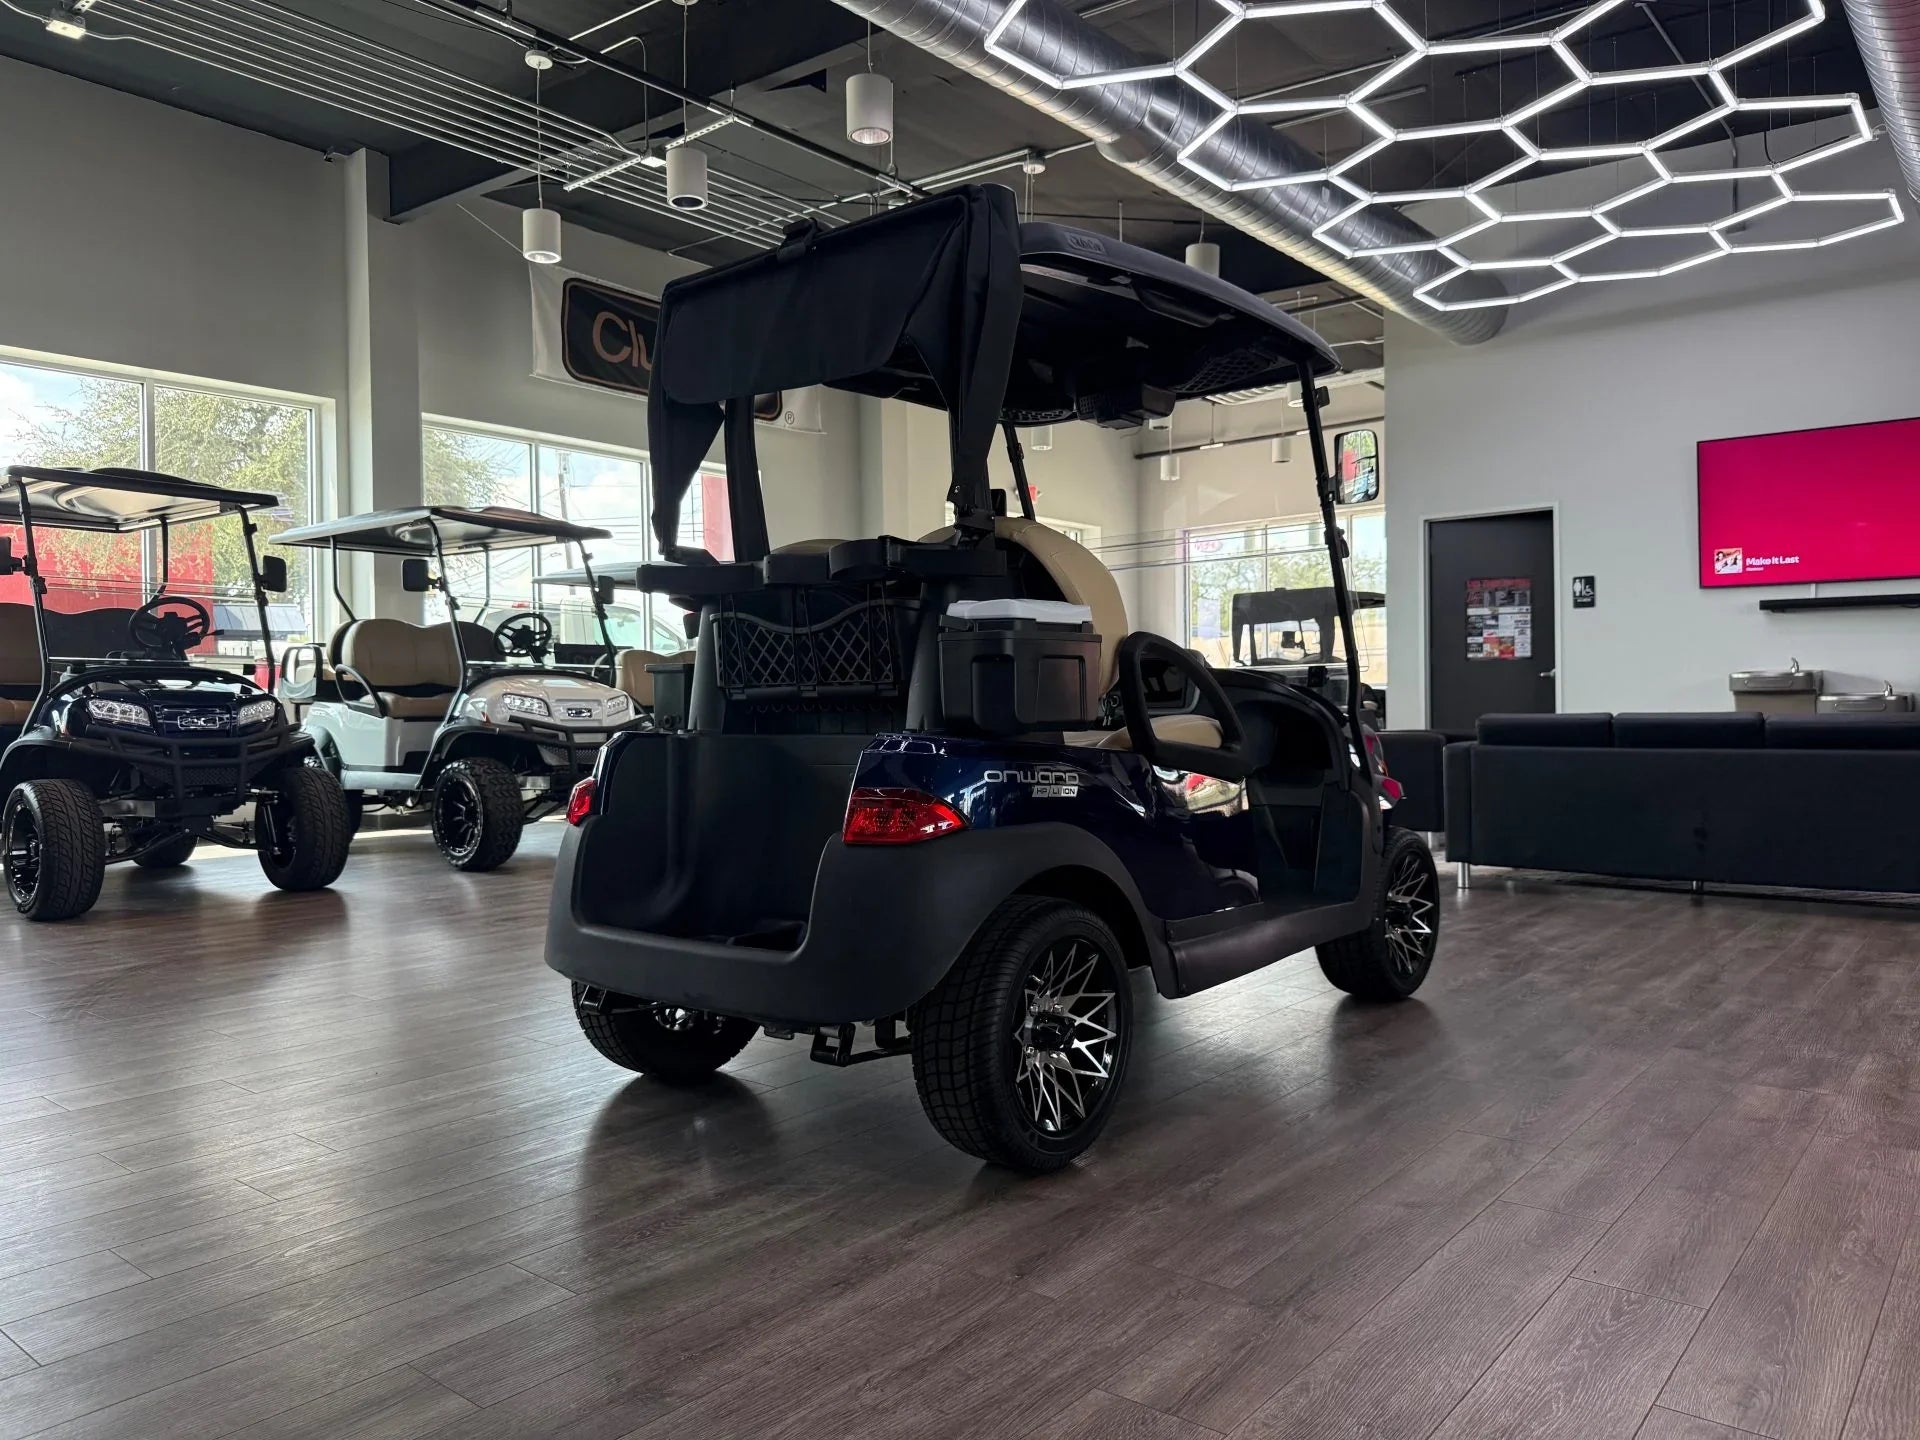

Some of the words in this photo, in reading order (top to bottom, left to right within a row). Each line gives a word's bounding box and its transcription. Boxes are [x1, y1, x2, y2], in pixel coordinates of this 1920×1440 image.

[1745, 558, 1771, 566] Make
[1771, 556, 1779, 565] It
[1779, 555, 1800, 565] Last
